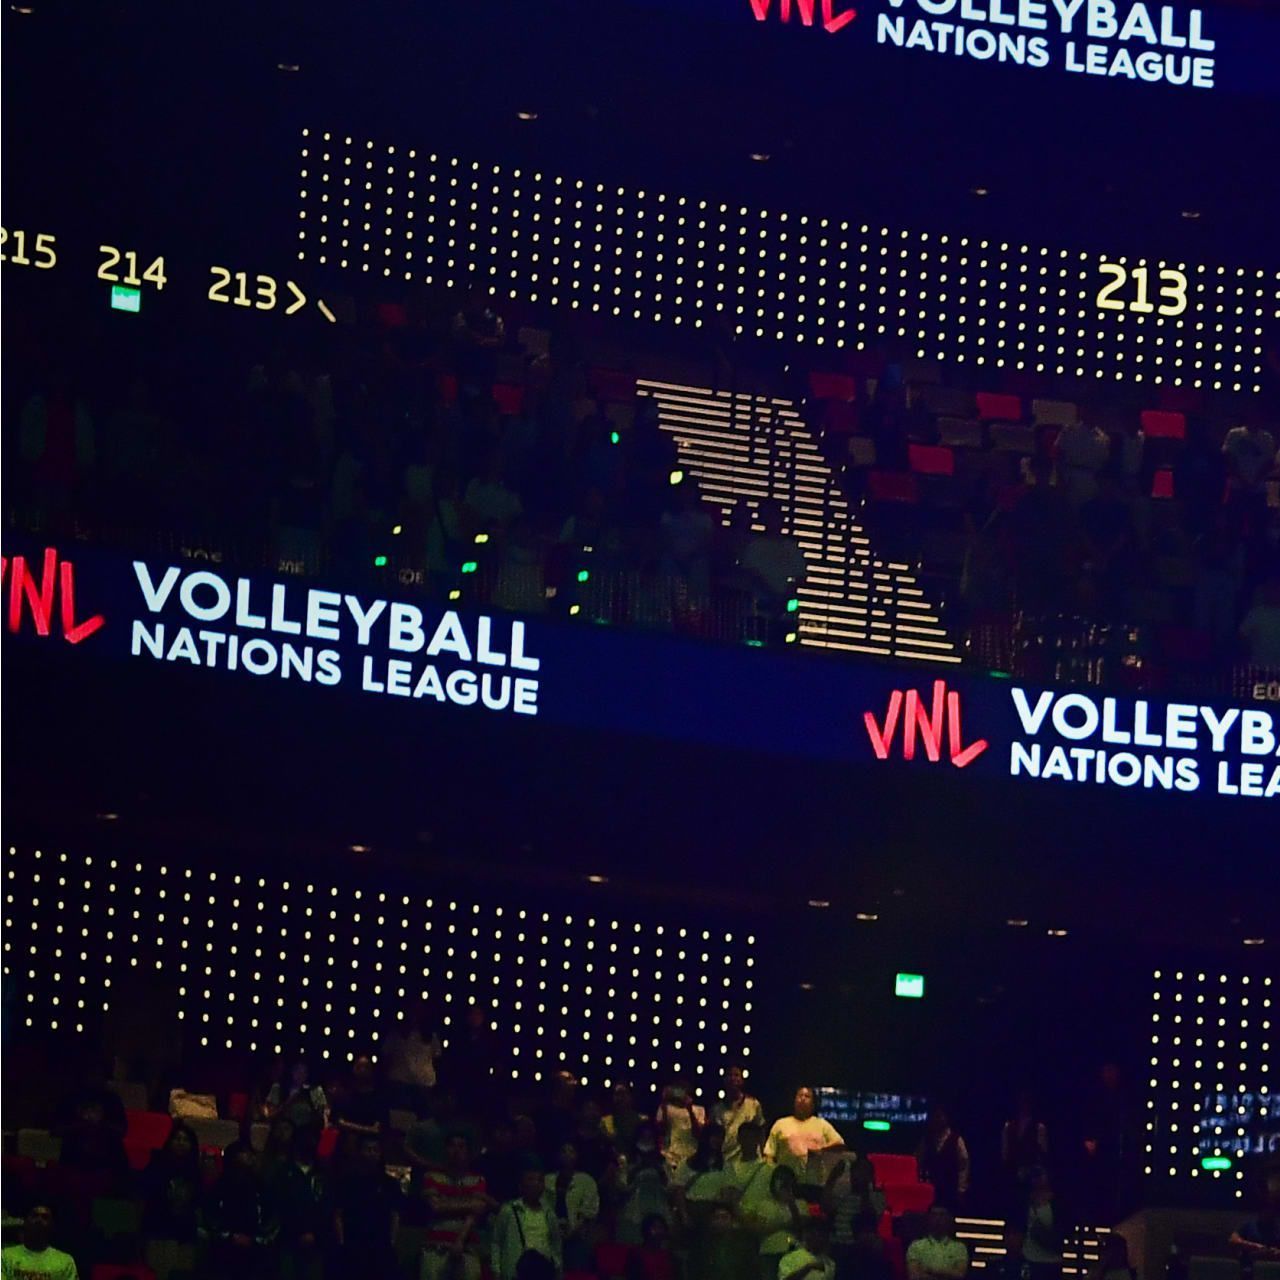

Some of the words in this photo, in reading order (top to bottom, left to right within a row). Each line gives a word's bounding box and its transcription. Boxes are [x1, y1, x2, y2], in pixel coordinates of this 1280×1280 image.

[876, 13, 1050, 68] NATIONS
[1065, 41, 1215, 88] LEAGUE
[887, 0, 1215, 51] LLEYBALL
[96, 246, 167, 290] 214
[208, 267, 277, 311] 213
[1096, 263, 1187, 316] 213
[1, 548, 105, 644] NL
[132, 560, 541, 672] VOLLEYBALL
[131, 620, 342, 686] NATIONS
[362, 654, 540, 716] LEAGUE
[863, 680, 988, 768] VNL
[1010, 741, 1200, 792] NATIONS
